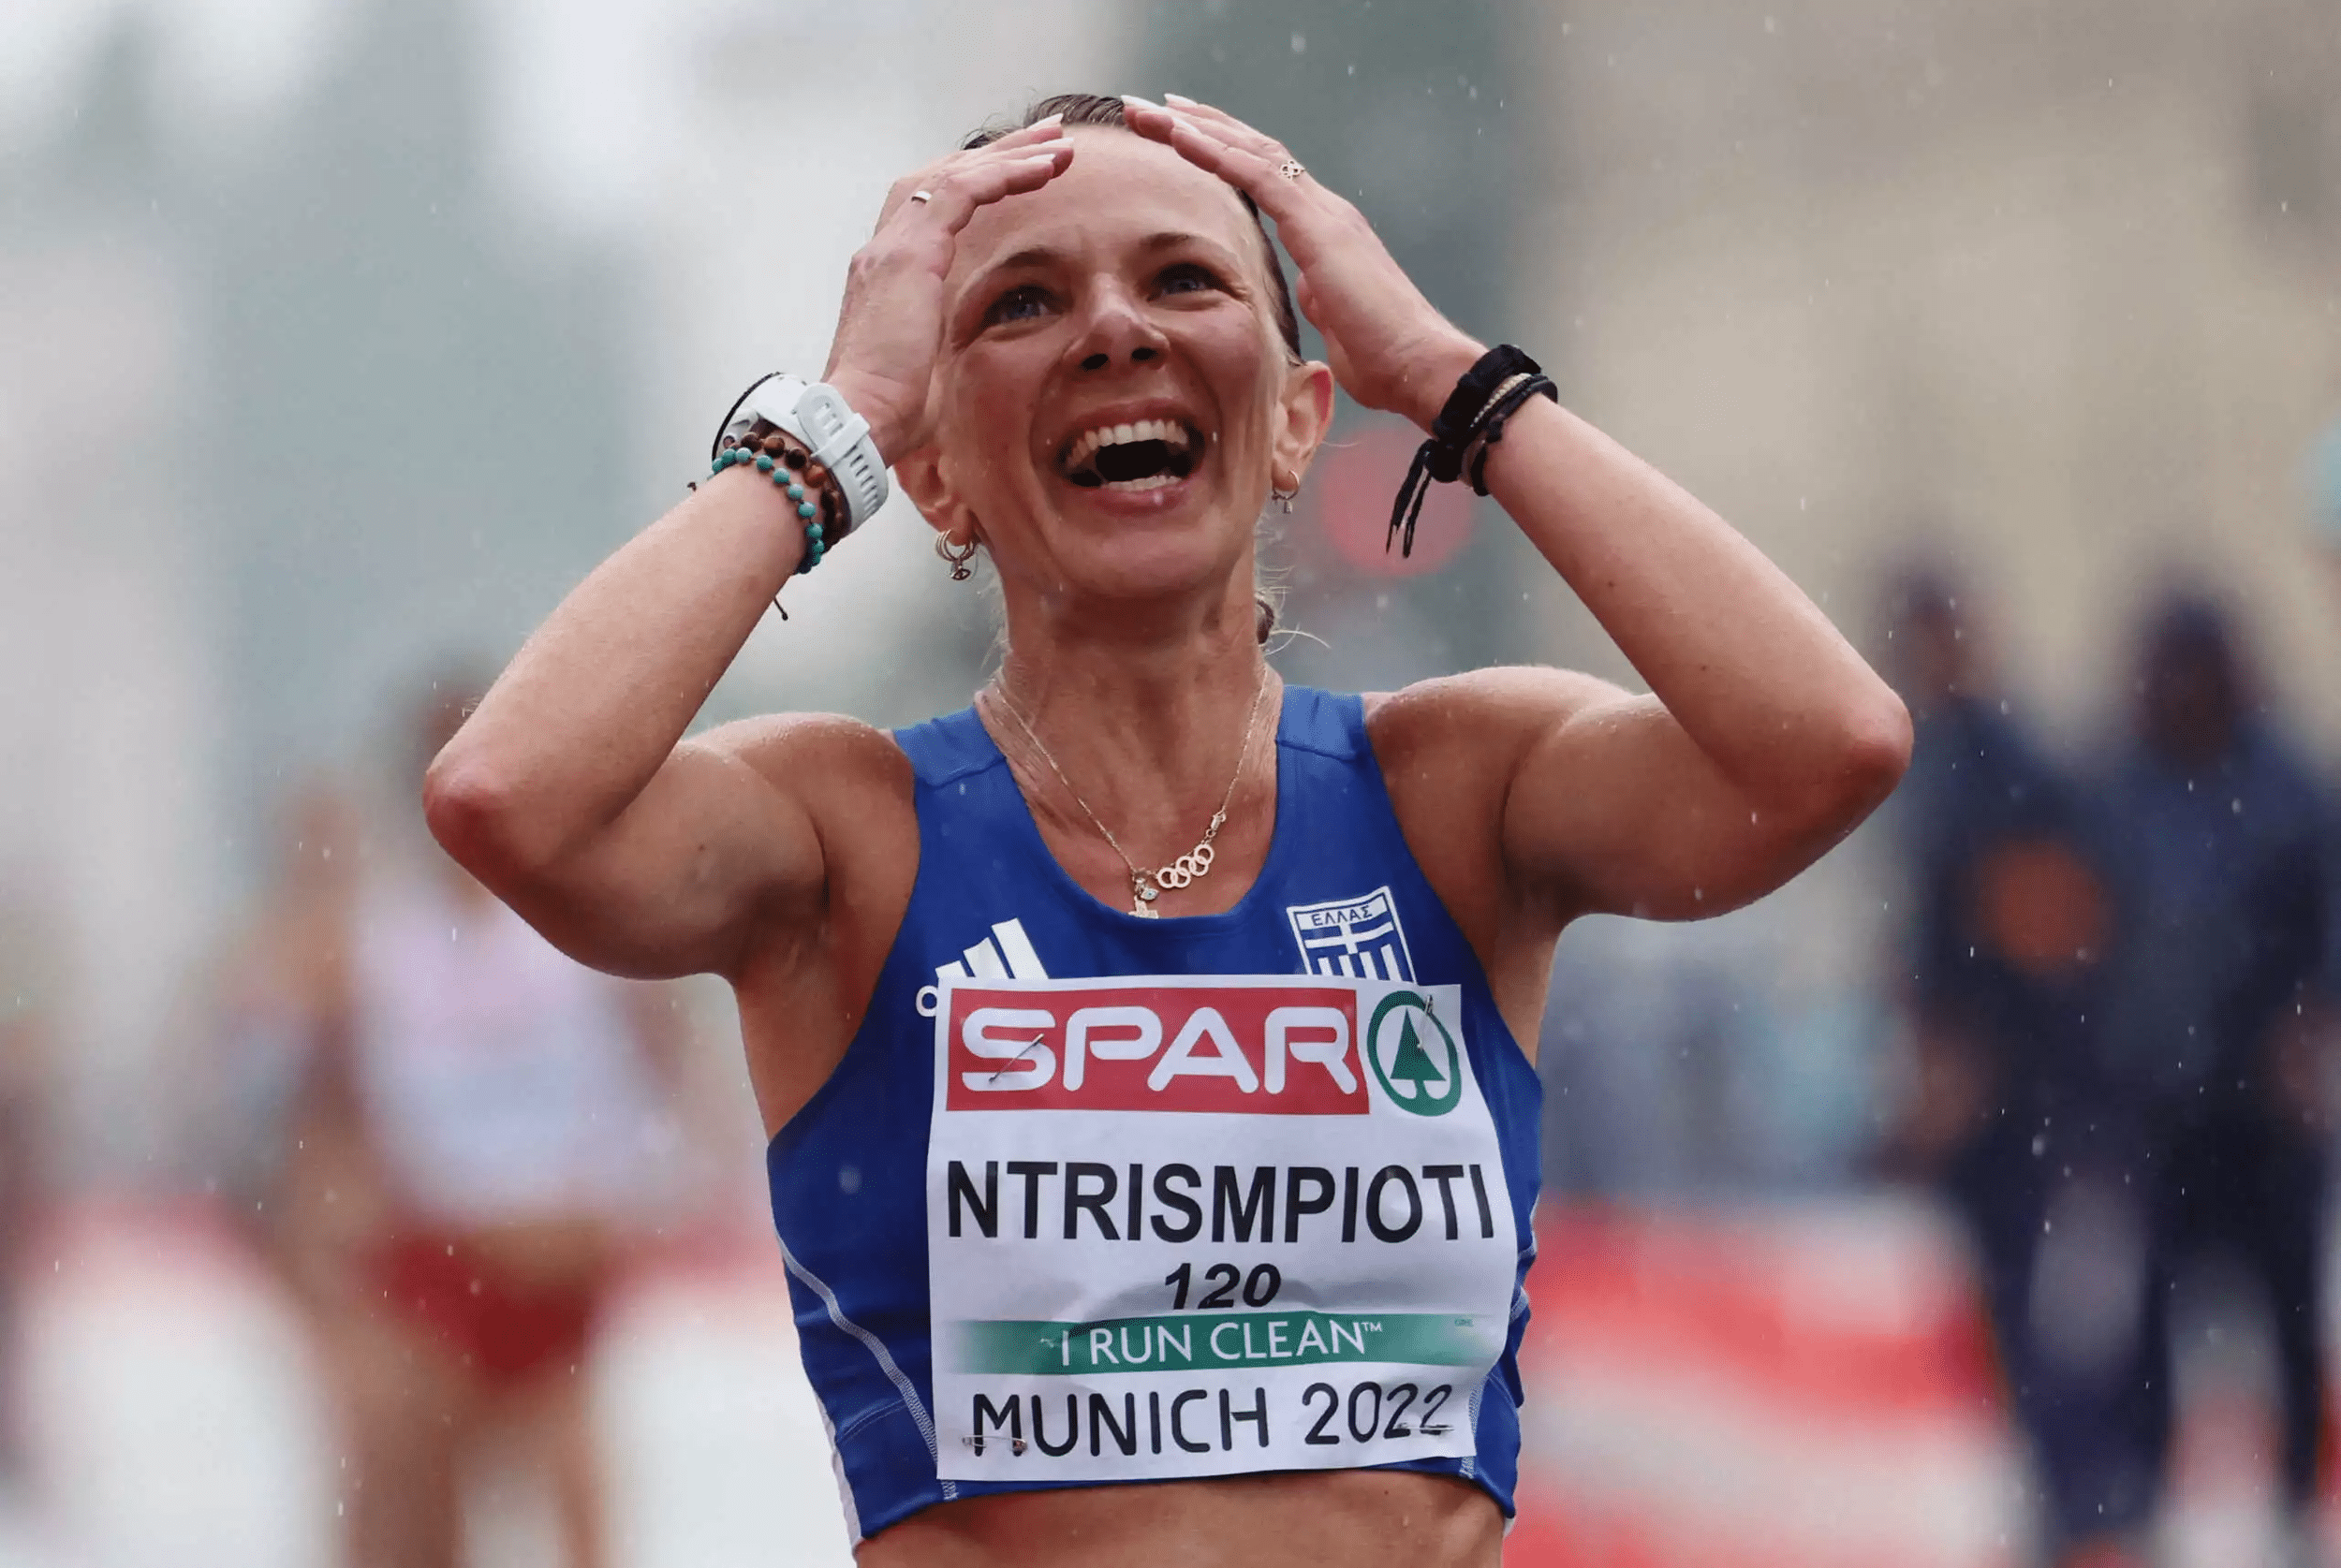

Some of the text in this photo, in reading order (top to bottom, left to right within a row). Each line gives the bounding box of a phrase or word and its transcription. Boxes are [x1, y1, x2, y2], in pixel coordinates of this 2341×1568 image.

[1311, 905, 1373, 926] ΕΛΛΑΣ
[962, 1006, 1357, 1094] SPAR
[948, 1161, 1494, 1242] NTRISMPIOTI
[1164, 1263, 1281, 1310] 120
[1061, 1330, 1069, 1366] I
[1090, 1324, 1193, 1365] RUN
[972, 1382, 1453, 1457] MUNICH 2022
